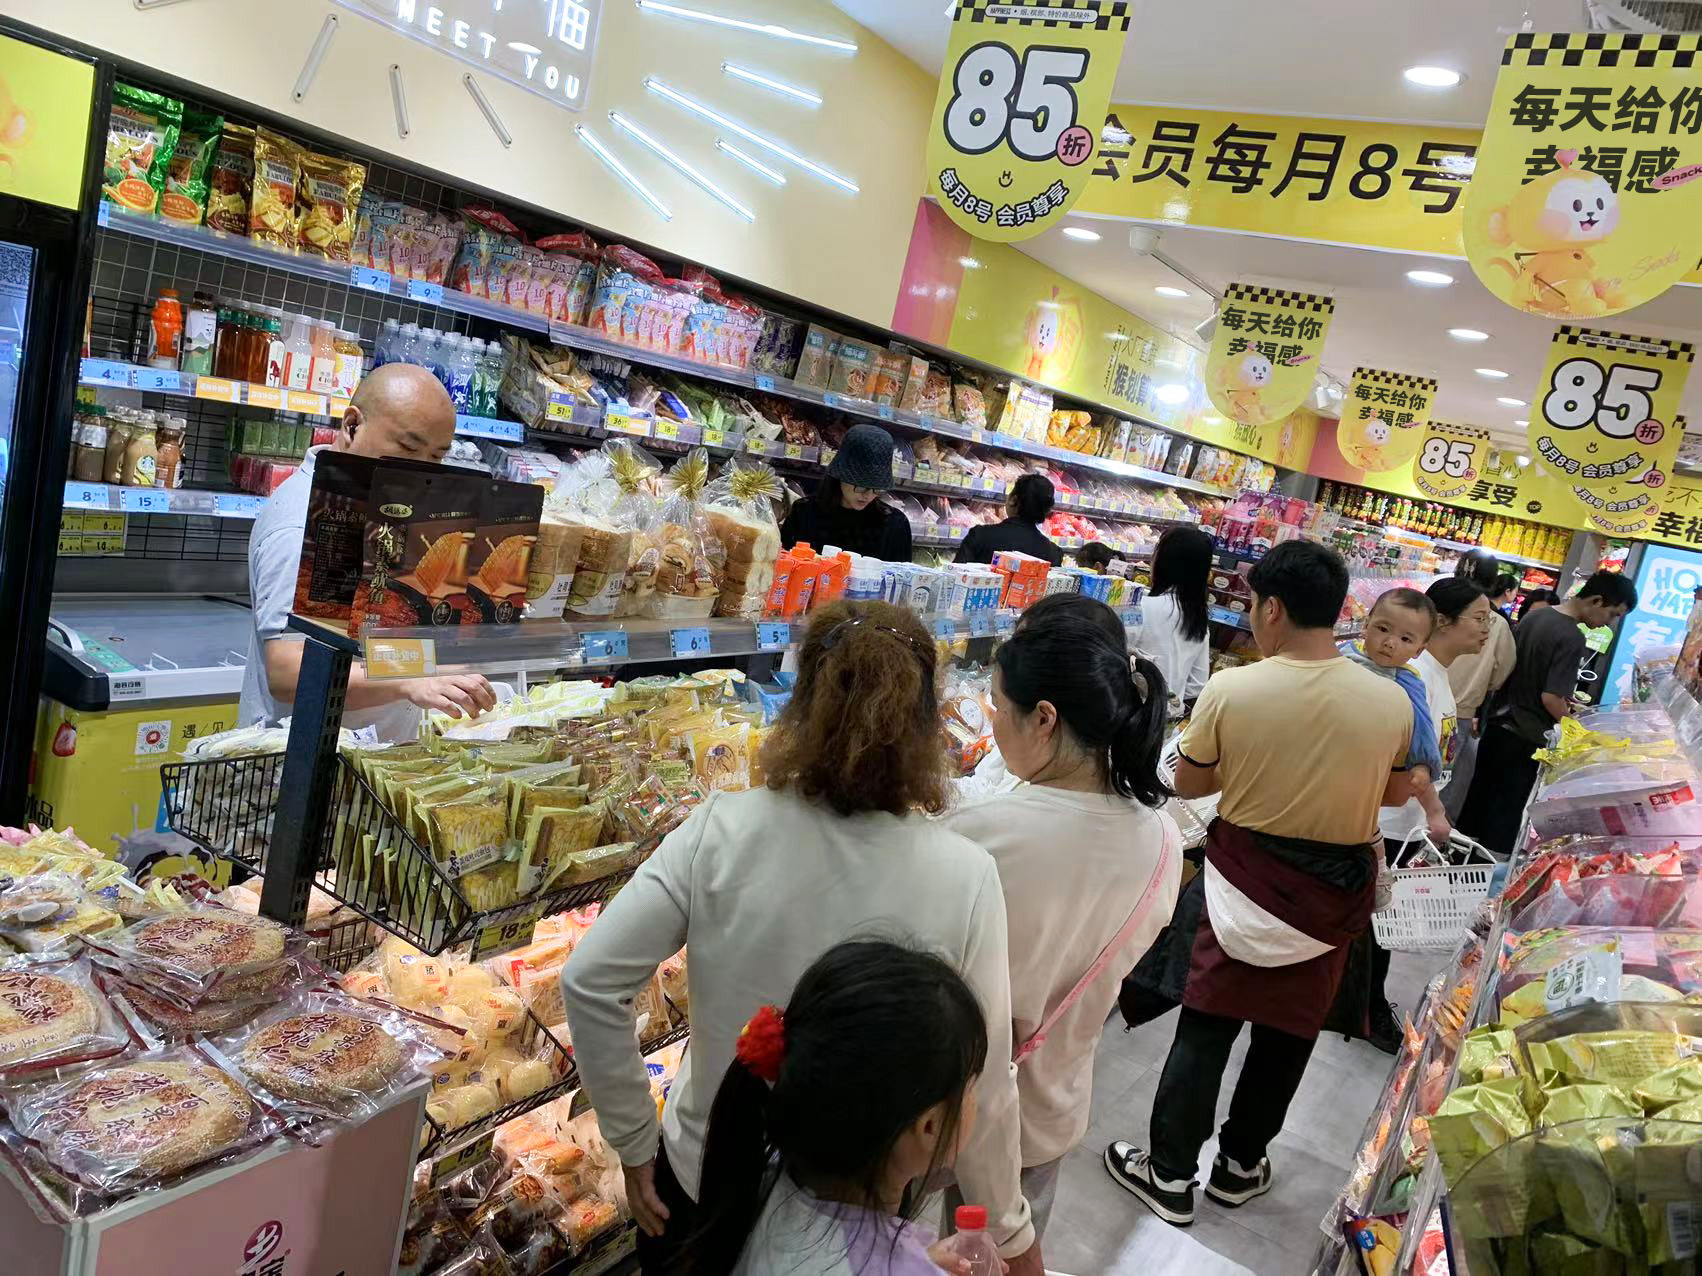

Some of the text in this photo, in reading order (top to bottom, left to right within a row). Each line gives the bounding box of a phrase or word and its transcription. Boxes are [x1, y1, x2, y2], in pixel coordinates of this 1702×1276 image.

[525, 53, 580, 100] YOU
[943, 40, 1090, 162] 85
[1062, 133, 1086, 158] 折
[939, 168, 1069, 227] 每月8号 会员尊享
[1221, 306, 1323, 341] 每天给你
[1354, 383, 1427, 411] 每天给你
[1542, 357, 1663, 439] 85
[1639, 423, 1657, 439] 折
[1419, 437, 1476, 478] 85
[1536, 436, 1581, 474] 每月8号
